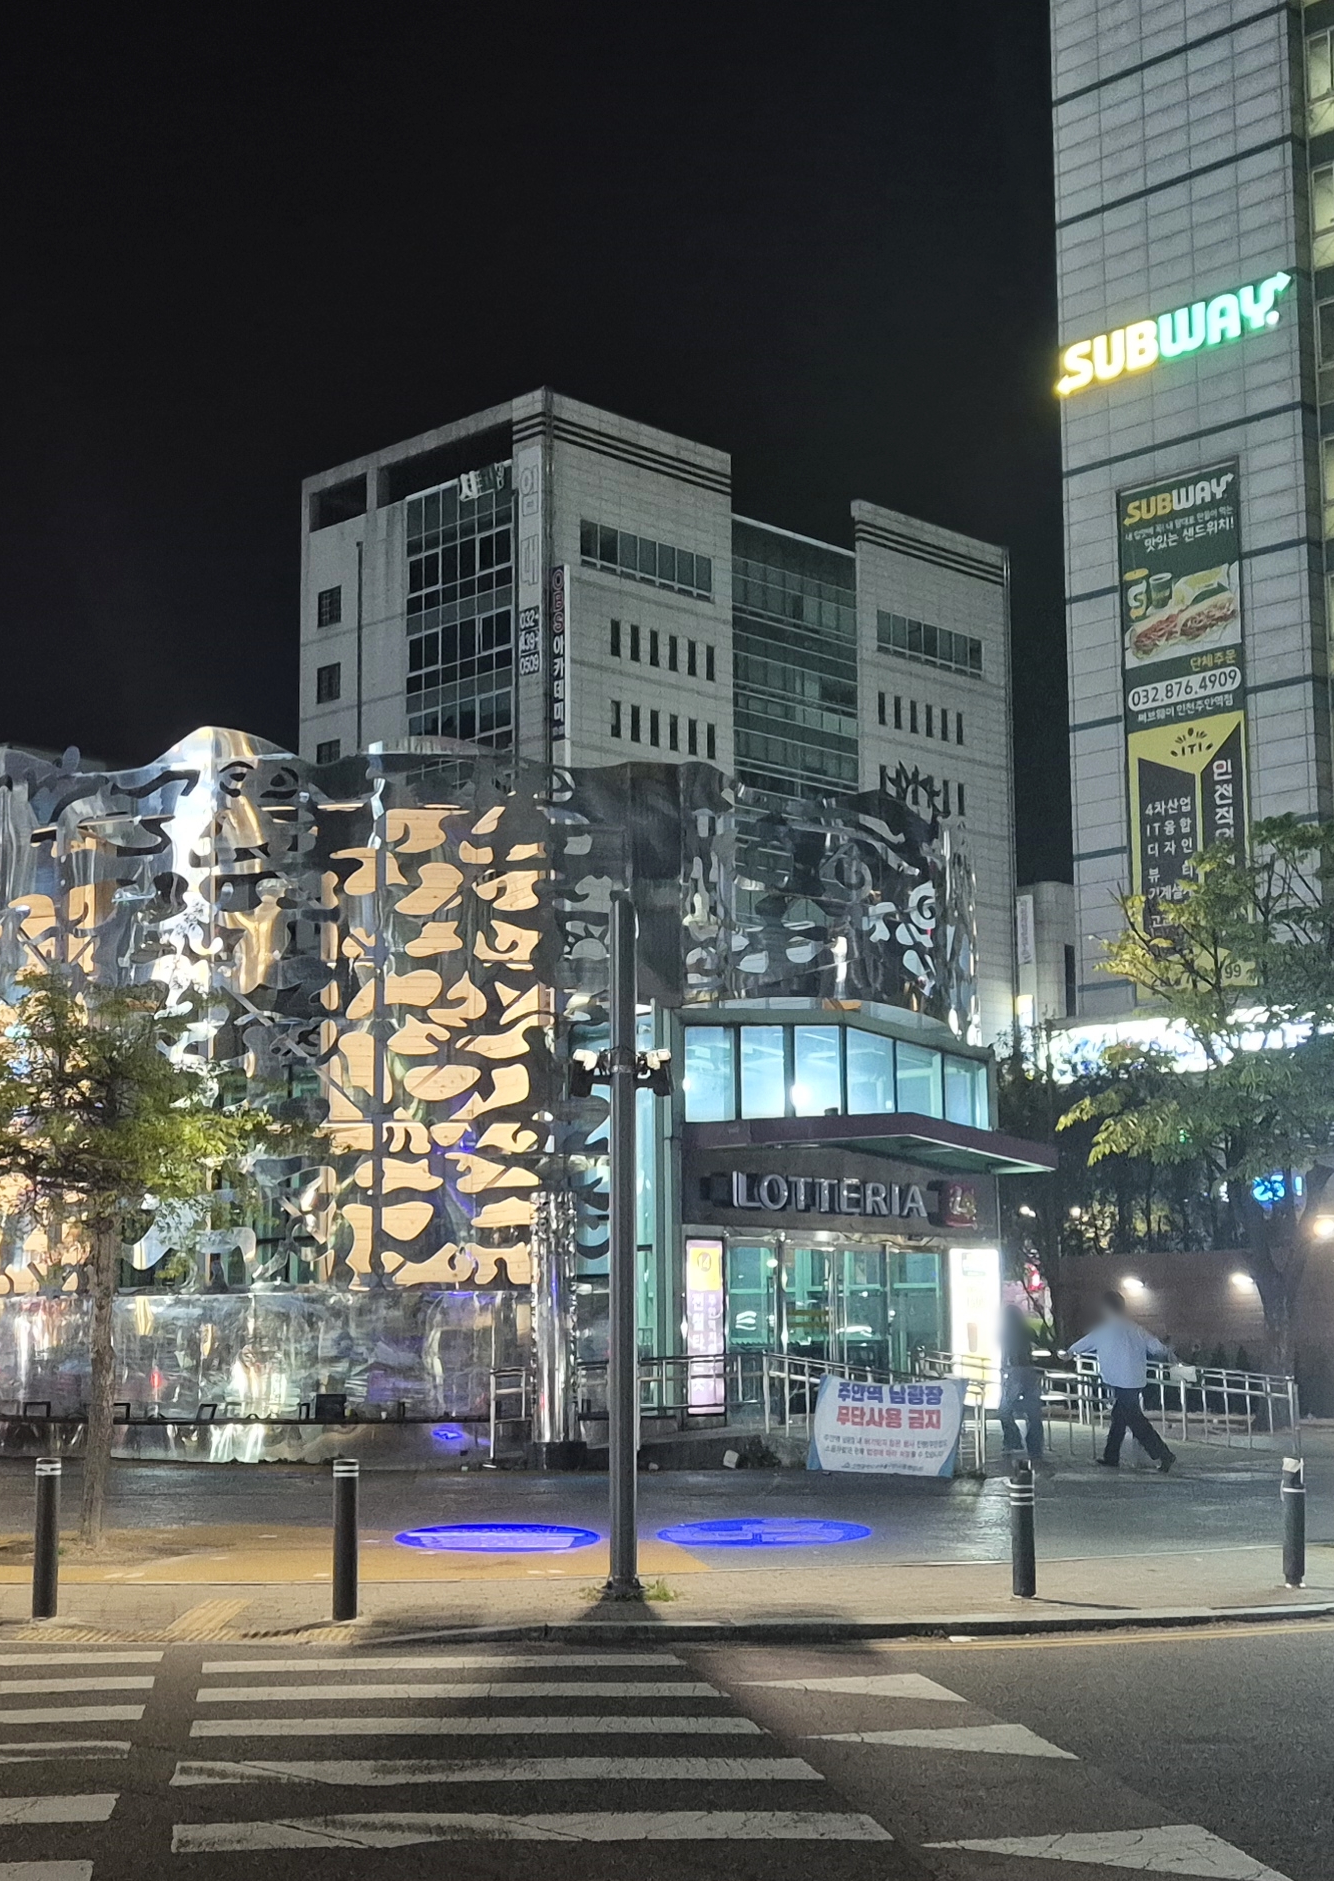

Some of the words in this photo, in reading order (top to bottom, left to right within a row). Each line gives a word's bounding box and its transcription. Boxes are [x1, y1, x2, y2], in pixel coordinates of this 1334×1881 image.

[1056, 271, 1292, 396] SUBWAY
[1123, 473, 1234, 527] SUBWAY
[1144, 533, 1180, 553] 맛있는
[1190, 649, 1237, 671] 단체주문
[1131, 669, 1238, 707] 032.876.4909
[1145, 796, 1192, 817] 4차산업
[1147, 837, 1193, 857] 디자인
[732, 1170, 928, 1218] LOTTERIA
[837, 1382, 884, 1404] 주안역
[889, 1385, 944, 1406] 남광장
[836, 1405, 903, 1429] 무단사용
[908, 1408, 942, 1430] 금지
